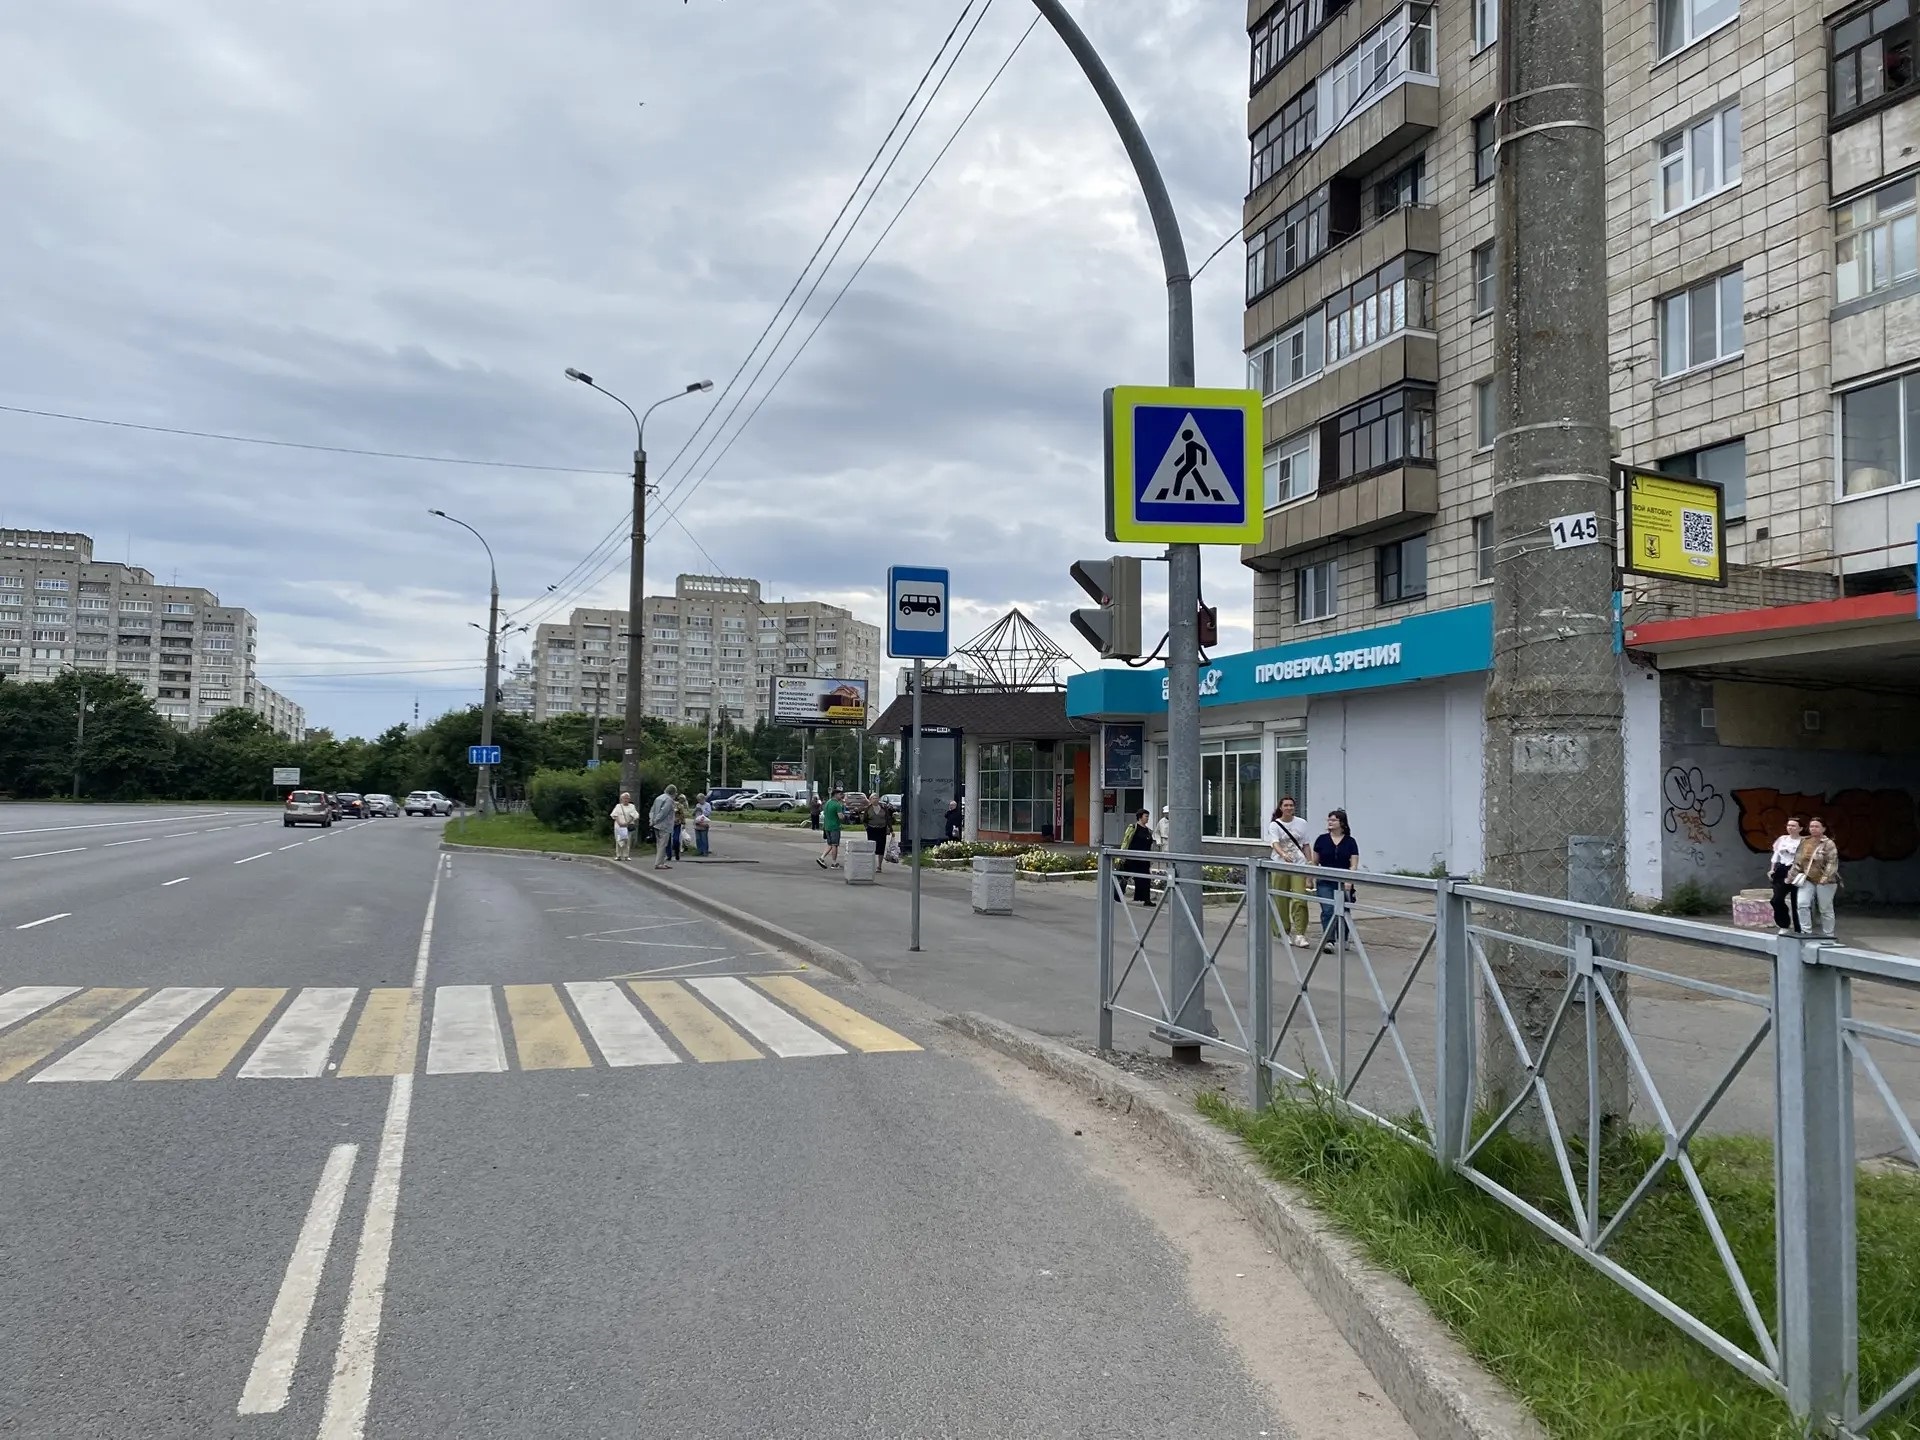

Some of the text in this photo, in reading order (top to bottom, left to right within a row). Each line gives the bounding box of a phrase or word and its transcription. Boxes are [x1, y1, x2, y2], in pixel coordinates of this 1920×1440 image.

[1646, 507, 1673, 516] АВТОБУС
[1553, 517, 1597, 544] 145
[1255, 642, 1402, 684] ПРОВЕРКА ЗРЕНИЯ
